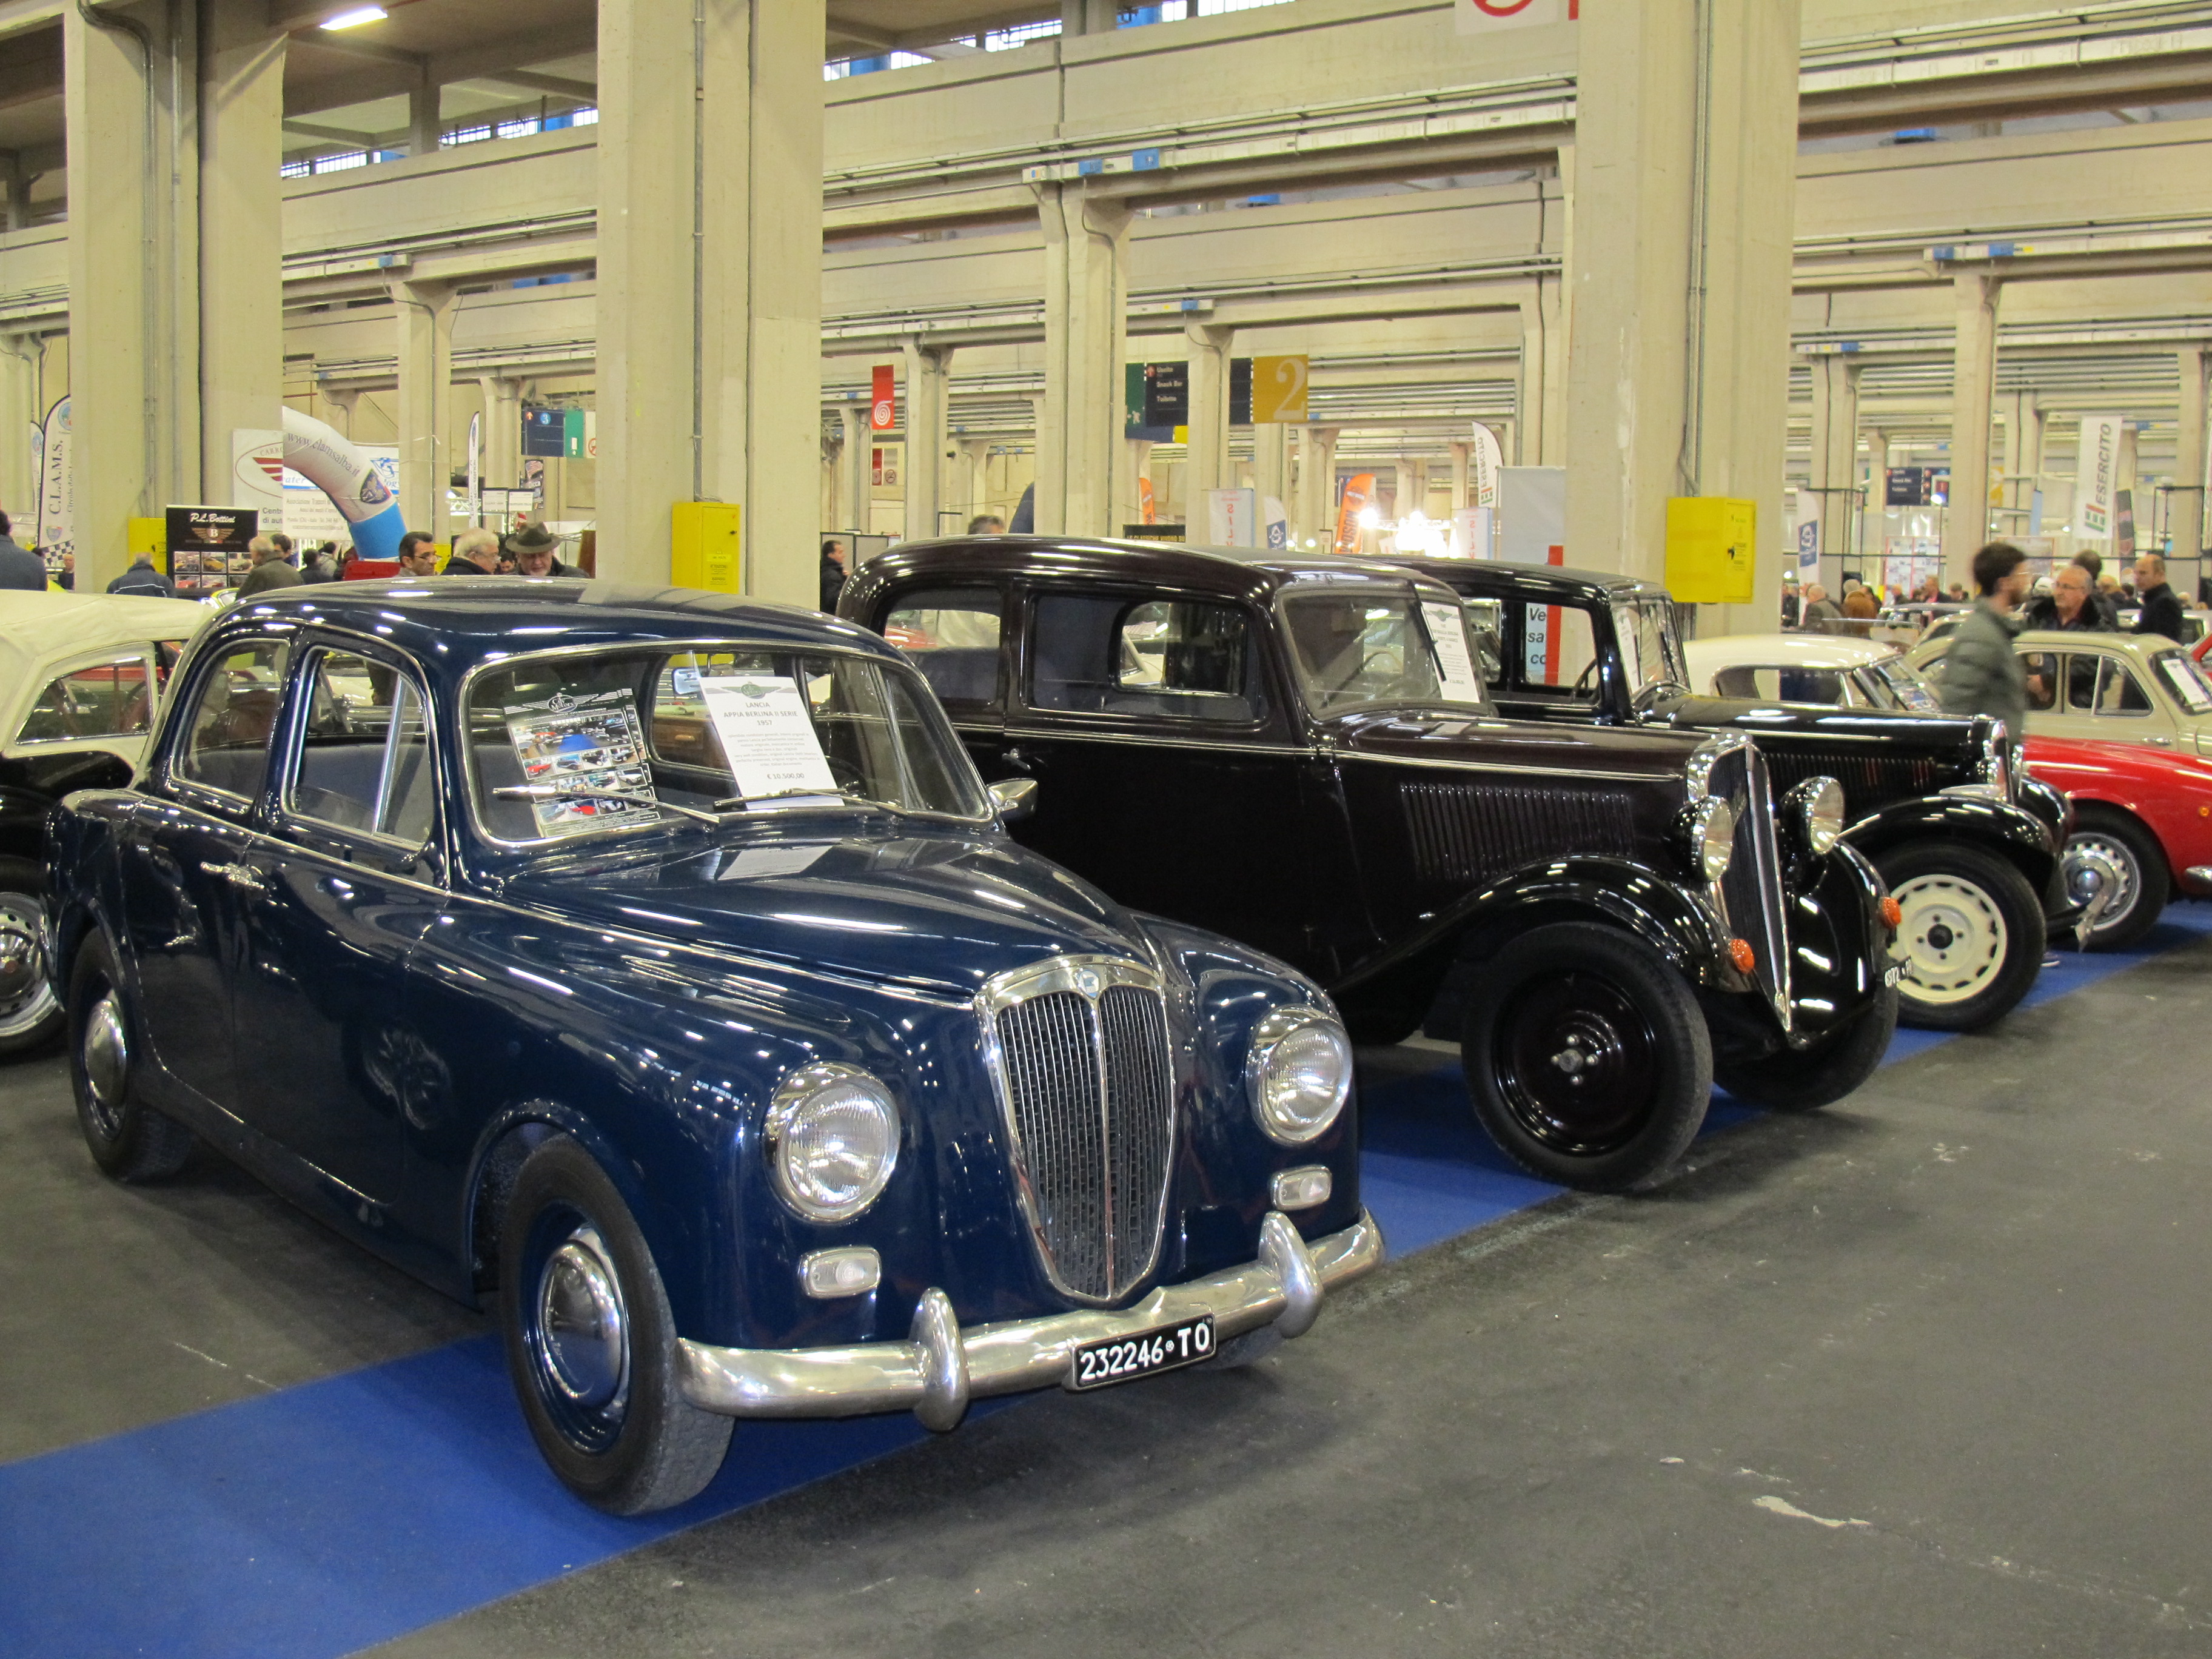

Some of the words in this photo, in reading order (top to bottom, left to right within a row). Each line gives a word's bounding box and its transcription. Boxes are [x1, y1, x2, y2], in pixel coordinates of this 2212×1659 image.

[1275, 358, 1307, 421] 2
[2095, 423, 2112, 506] ESERCITO
[1080, 1336, 1164, 1381] 232246
[1178, 1322, 1210, 1357] TO
